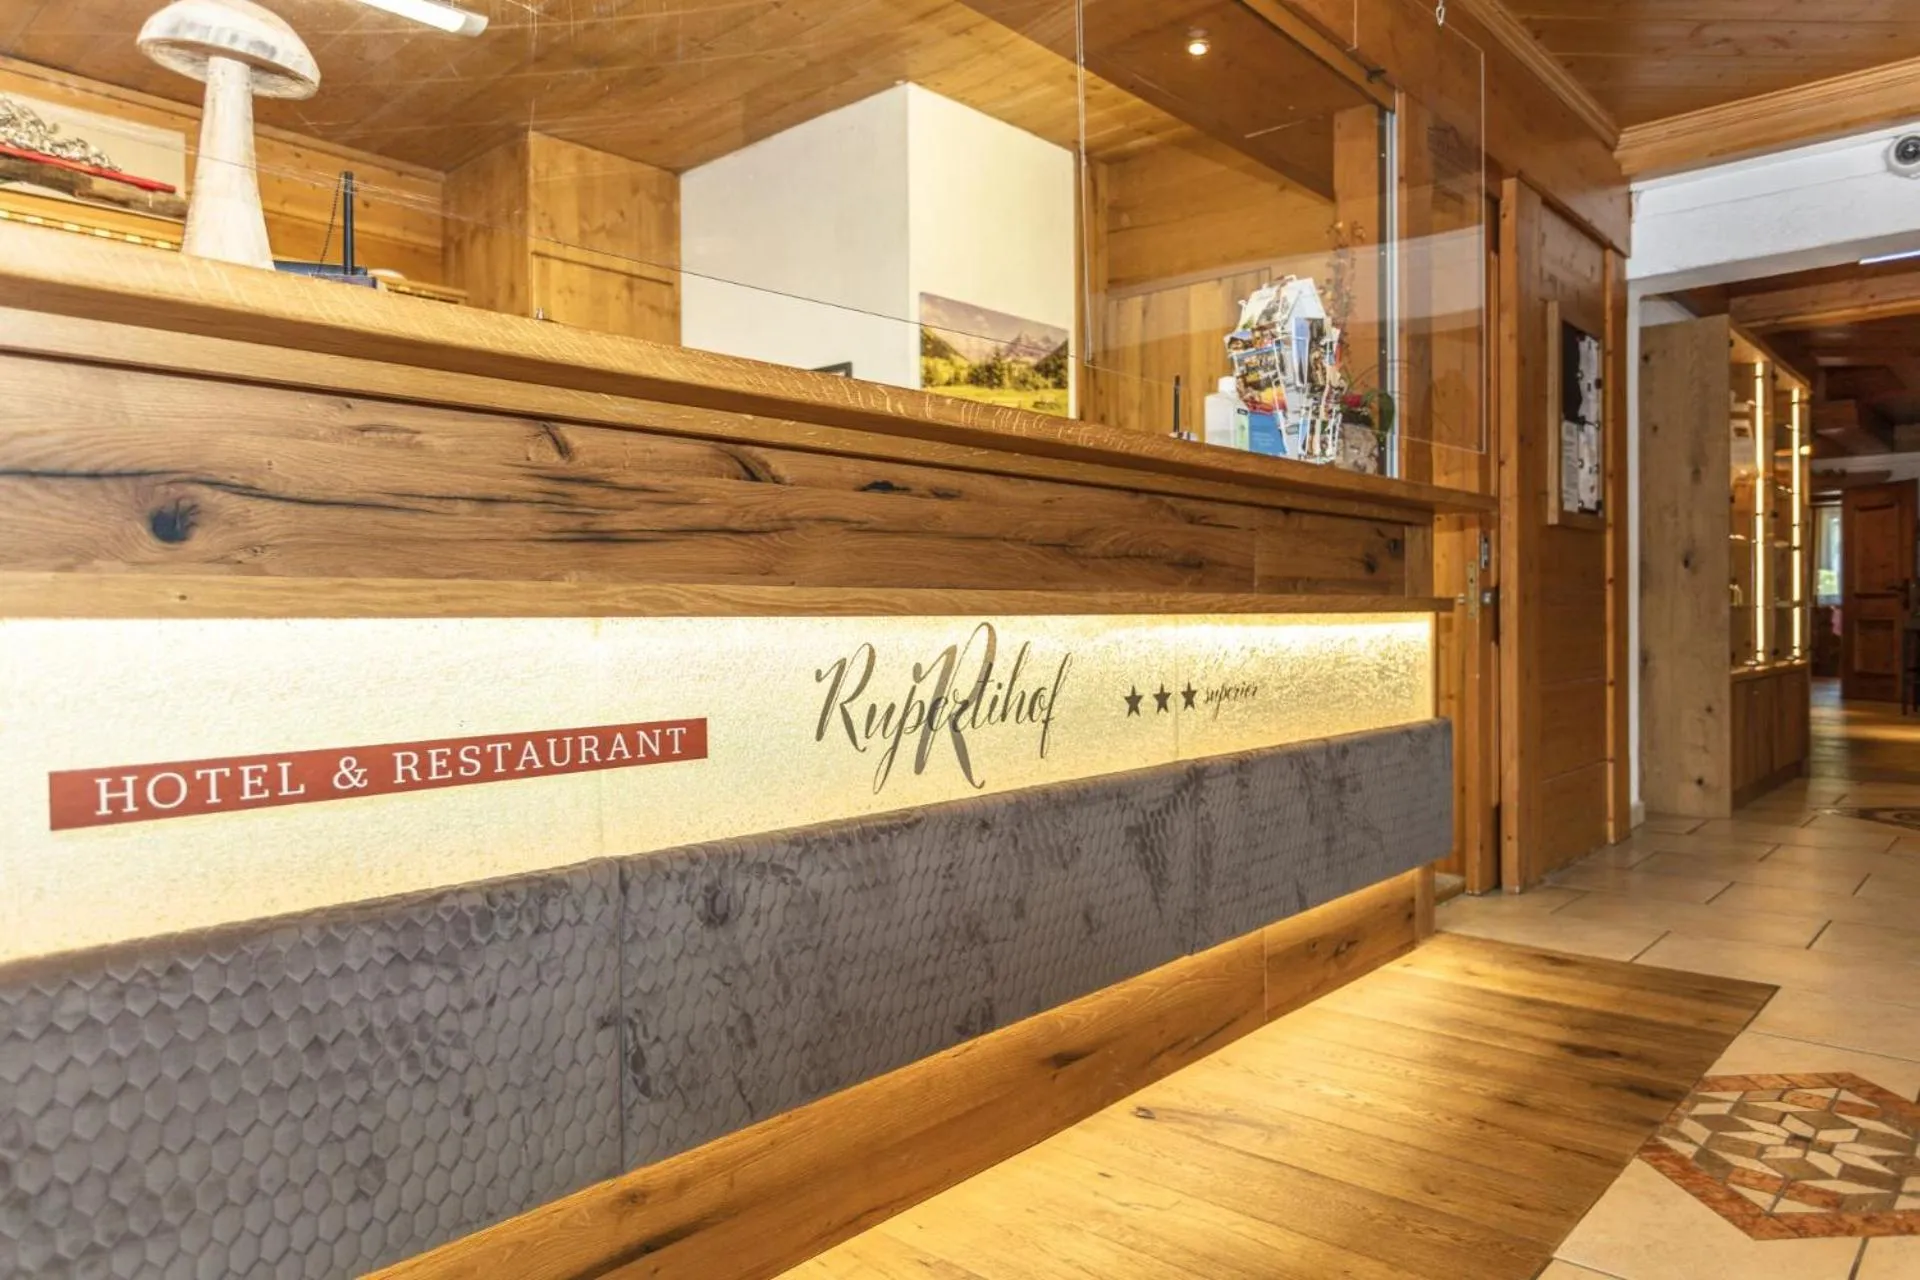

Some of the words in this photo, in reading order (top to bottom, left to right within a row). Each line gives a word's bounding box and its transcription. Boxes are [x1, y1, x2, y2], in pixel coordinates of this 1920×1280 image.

[95, 761, 305, 816] HOTEL
[332, 755, 368, 790] &
[392, 727, 687, 785] RESTAURANT
[815, 640, 1072, 795] Rupertihof
